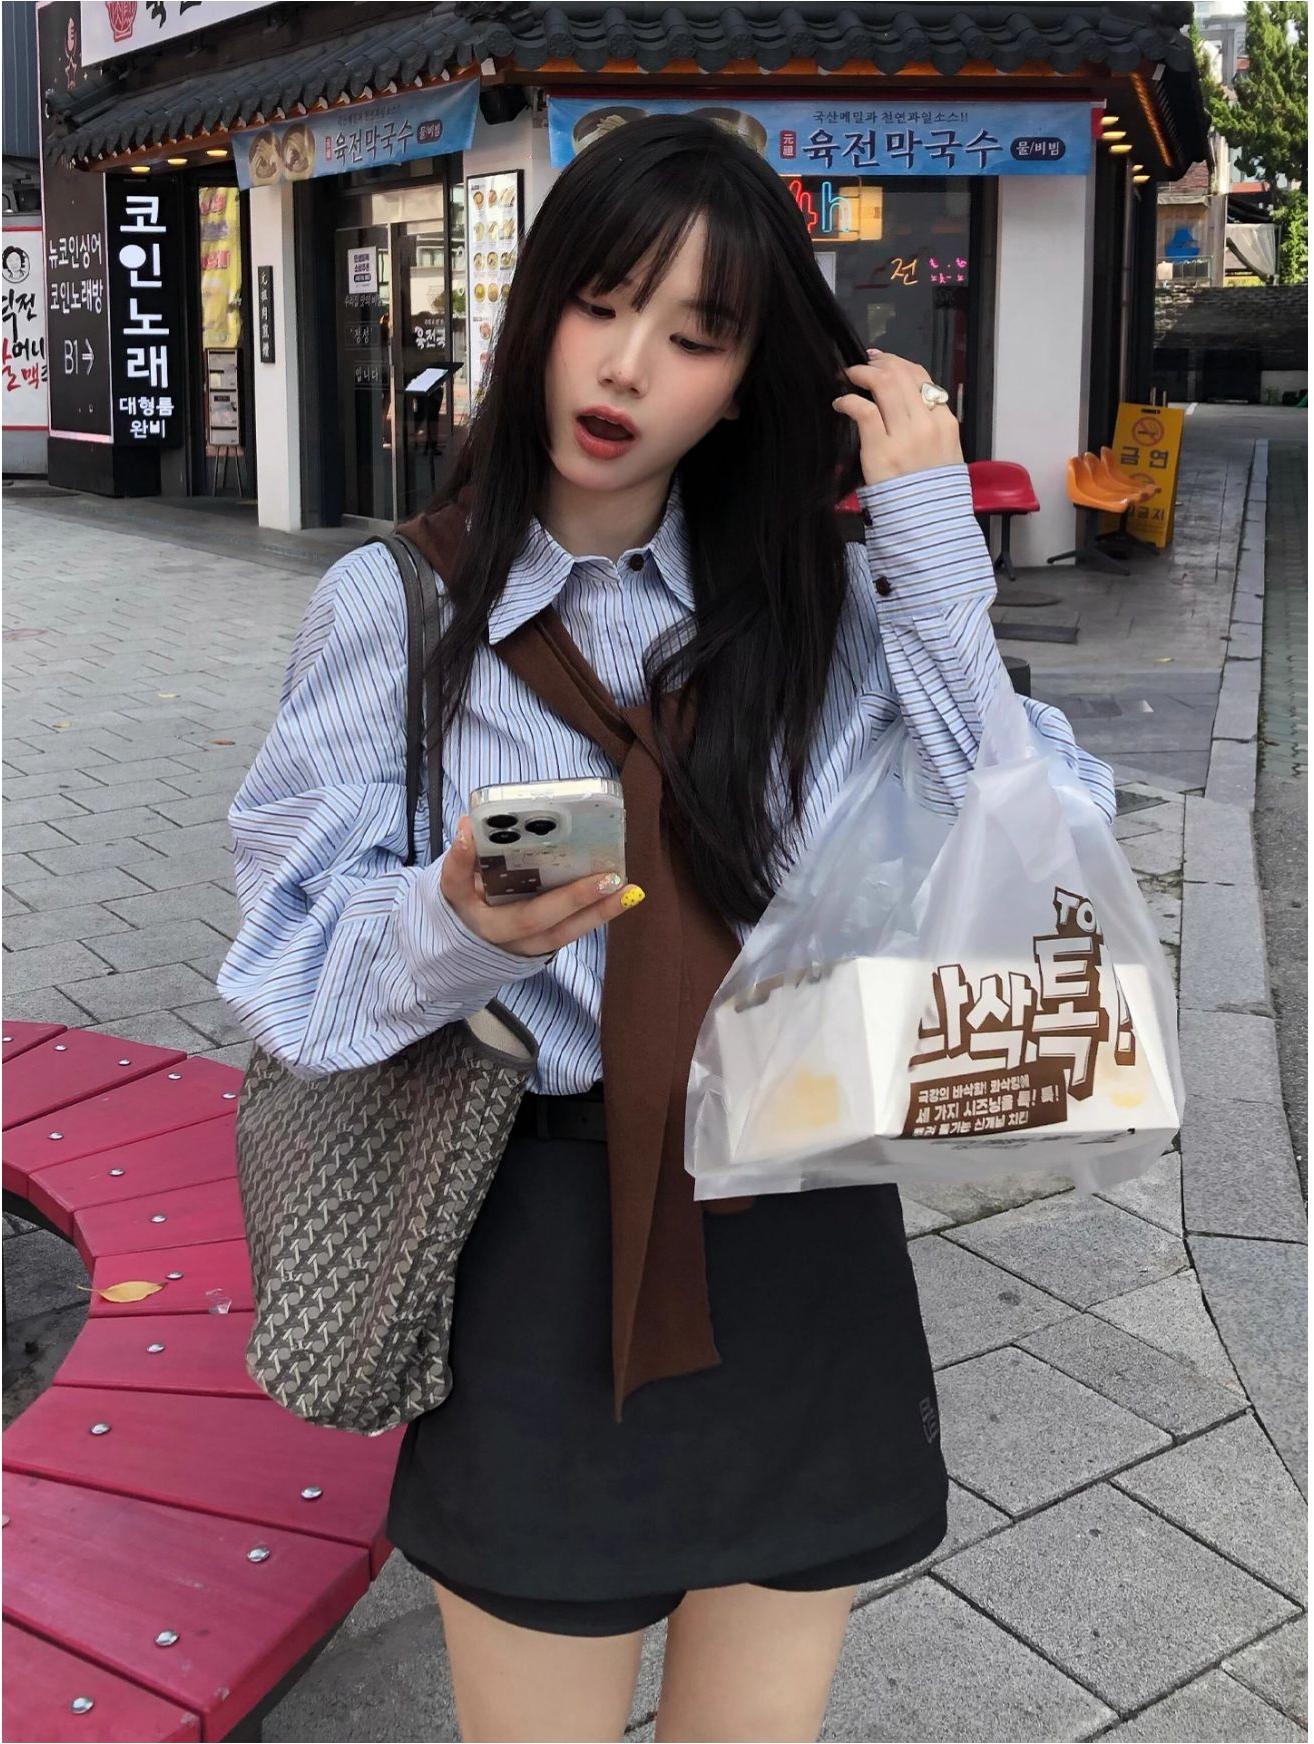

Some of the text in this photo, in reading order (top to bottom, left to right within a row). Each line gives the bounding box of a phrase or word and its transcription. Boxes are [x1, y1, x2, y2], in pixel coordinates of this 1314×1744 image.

[813, 110, 969, 124] 국산메밀과 천연과일소스!!
[333, 120, 414, 166] 육전막국수
[801, 127, 1060, 170] 육전막국수 물/비빔
[48, 232, 102, 270] 뉴코인싱어
[889, 257, 919, 286] 전
[50, 279, 104, 315] 코인노래방
[63, 339, 79, 375] B1
[118, 396, 175, 417] 대형룸
[129, 419, 166, 440] 완비
[1120, 446, 1169, 469] 금연
[915, 1106, 930, 1124] 세
[934, 1103, 959, 1121] 가지
[963, 1095, 1013, 1119] 시즈닝을
